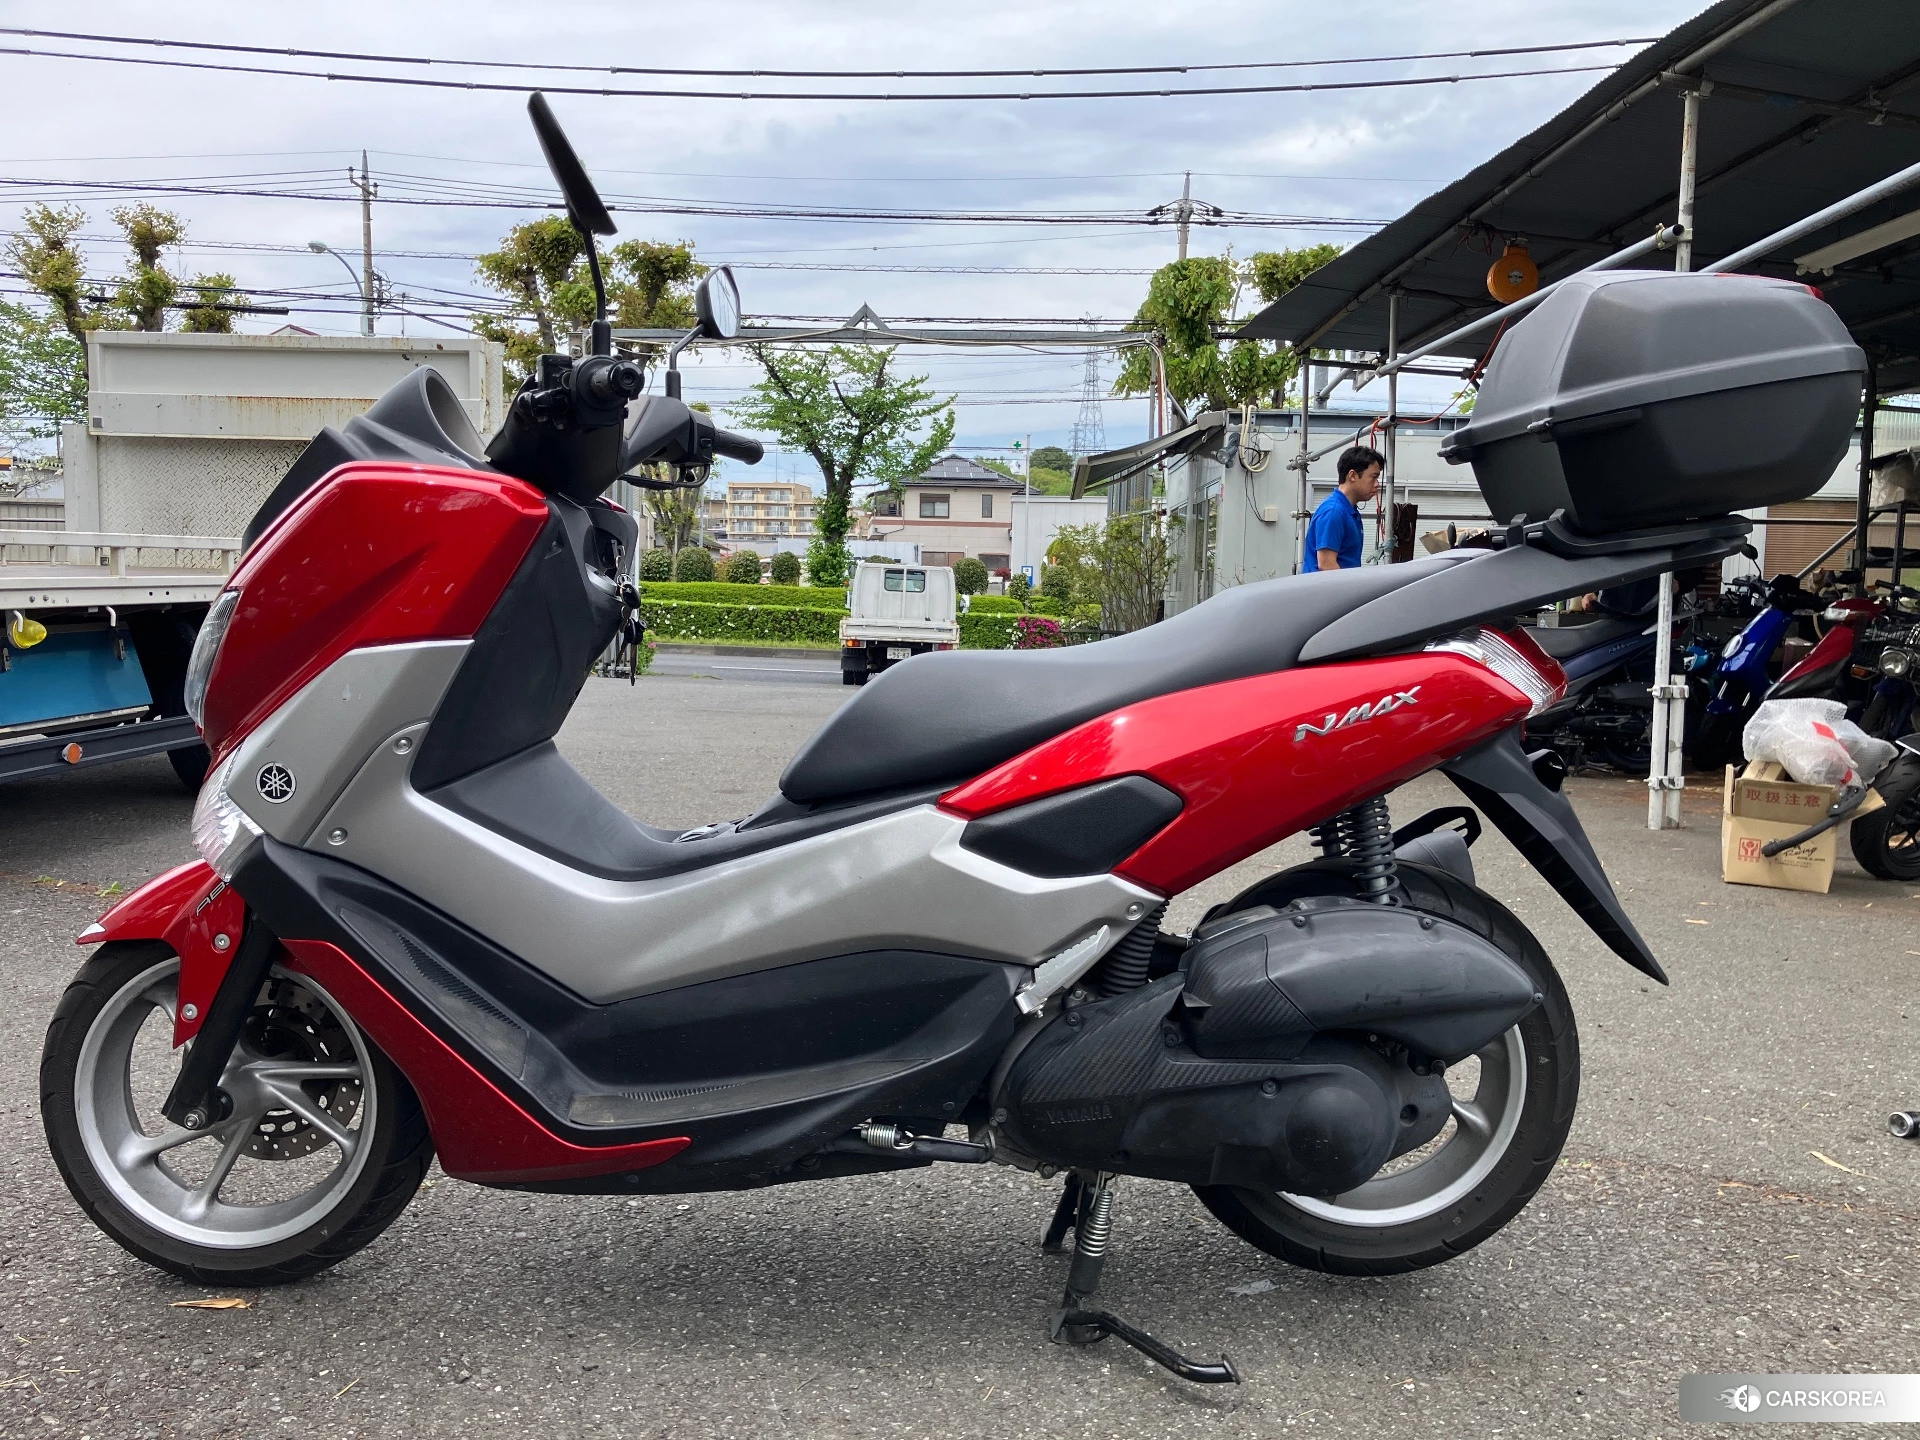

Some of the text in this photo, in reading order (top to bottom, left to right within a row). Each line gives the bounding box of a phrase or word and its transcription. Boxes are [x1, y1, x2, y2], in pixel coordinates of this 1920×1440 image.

[1293, 685, 1421, 742] NMAX
[1745, 788, 1822, 808] 取扱注意
[196, 881, 229, 917] AB
[1046, 1103, 1113, 1124] YAMAHA
